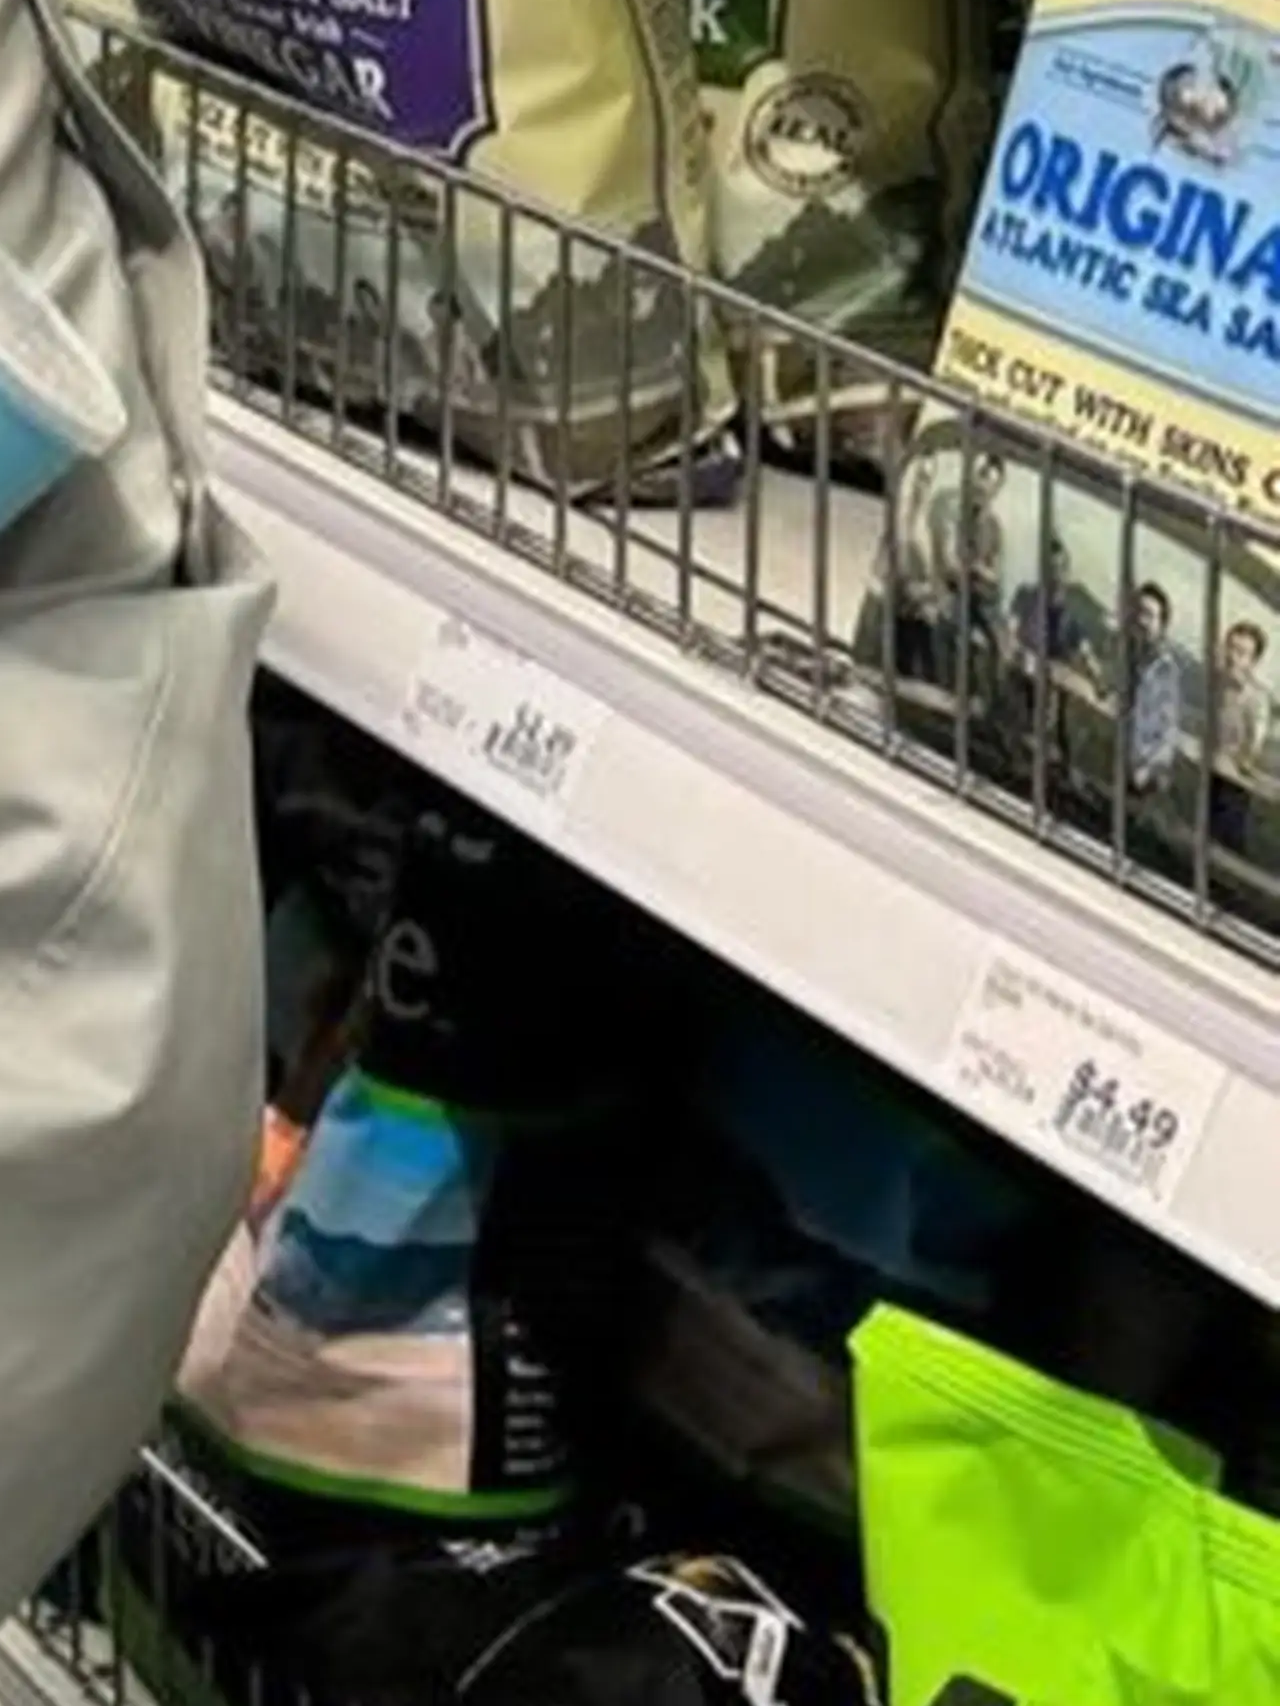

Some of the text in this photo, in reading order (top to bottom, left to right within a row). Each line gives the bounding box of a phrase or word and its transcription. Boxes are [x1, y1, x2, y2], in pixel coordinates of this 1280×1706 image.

[980, 206, 1139, 303] ATLANTIC
[1140, 272, 1213, 336] SEA
[1006, 356, 1067, 406] CUT
[1072, 384, 1157, 446] WITH
[1065, 1056, 1180, 1150] $4.49
